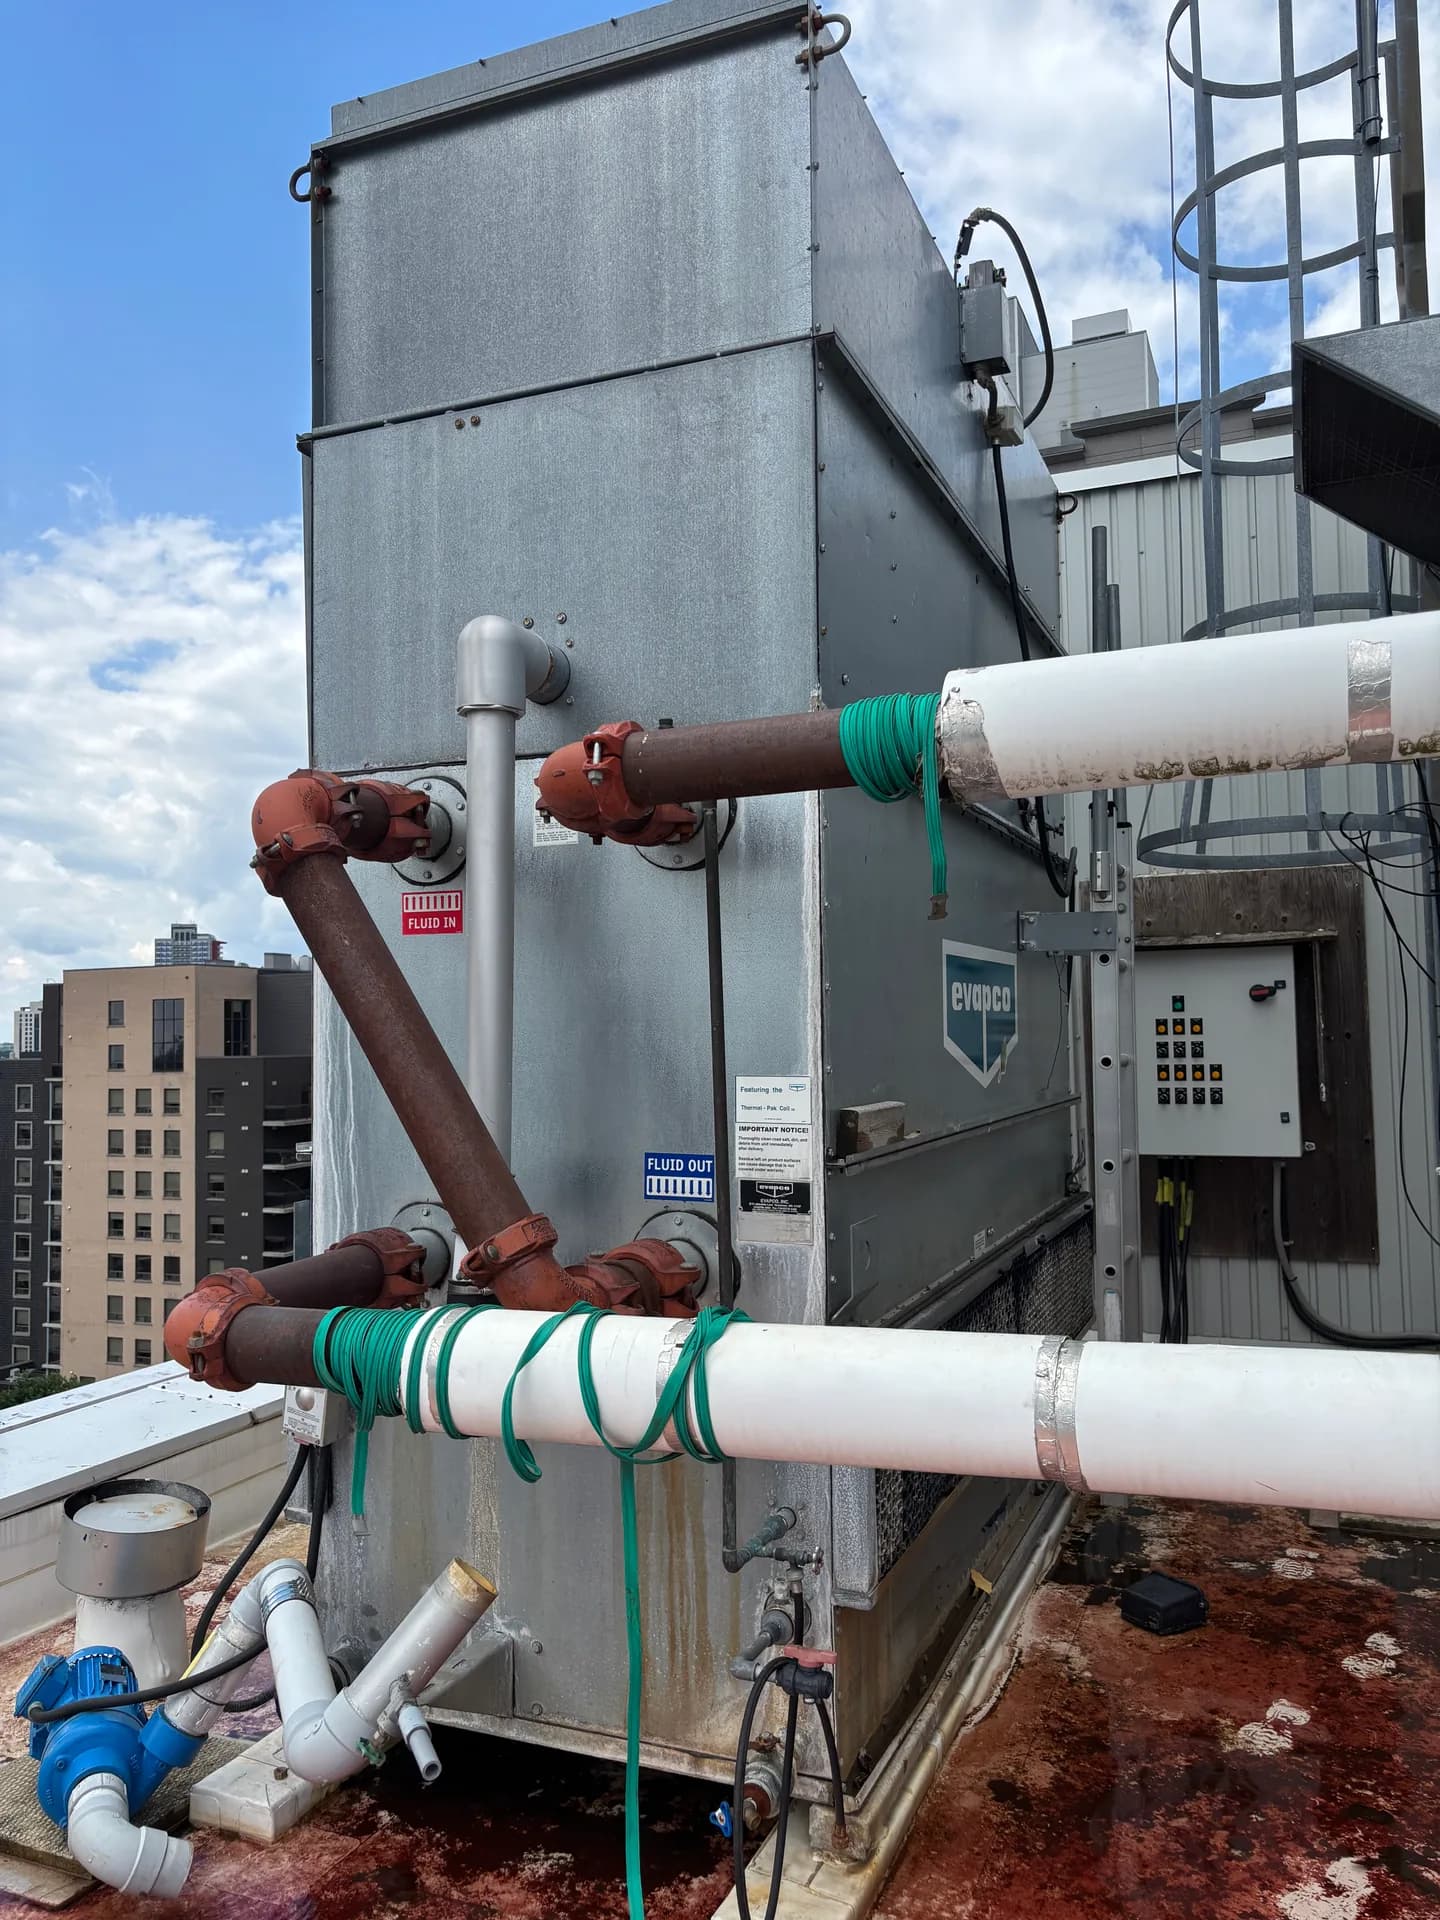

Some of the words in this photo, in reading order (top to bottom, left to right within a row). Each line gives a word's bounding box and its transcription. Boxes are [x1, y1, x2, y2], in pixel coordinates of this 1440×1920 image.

[408, 917, 440, 929] FLUID
[443, 916, 456, 928] IN
[951, 981, 1011, 1012] evapco
[740, 1086, 770, 1094] Featuring
[772, 1086, 783, 1094] the
[647, 1158, 684, 1171] FLUID
[688, 1159, 713, 1173] OUT
